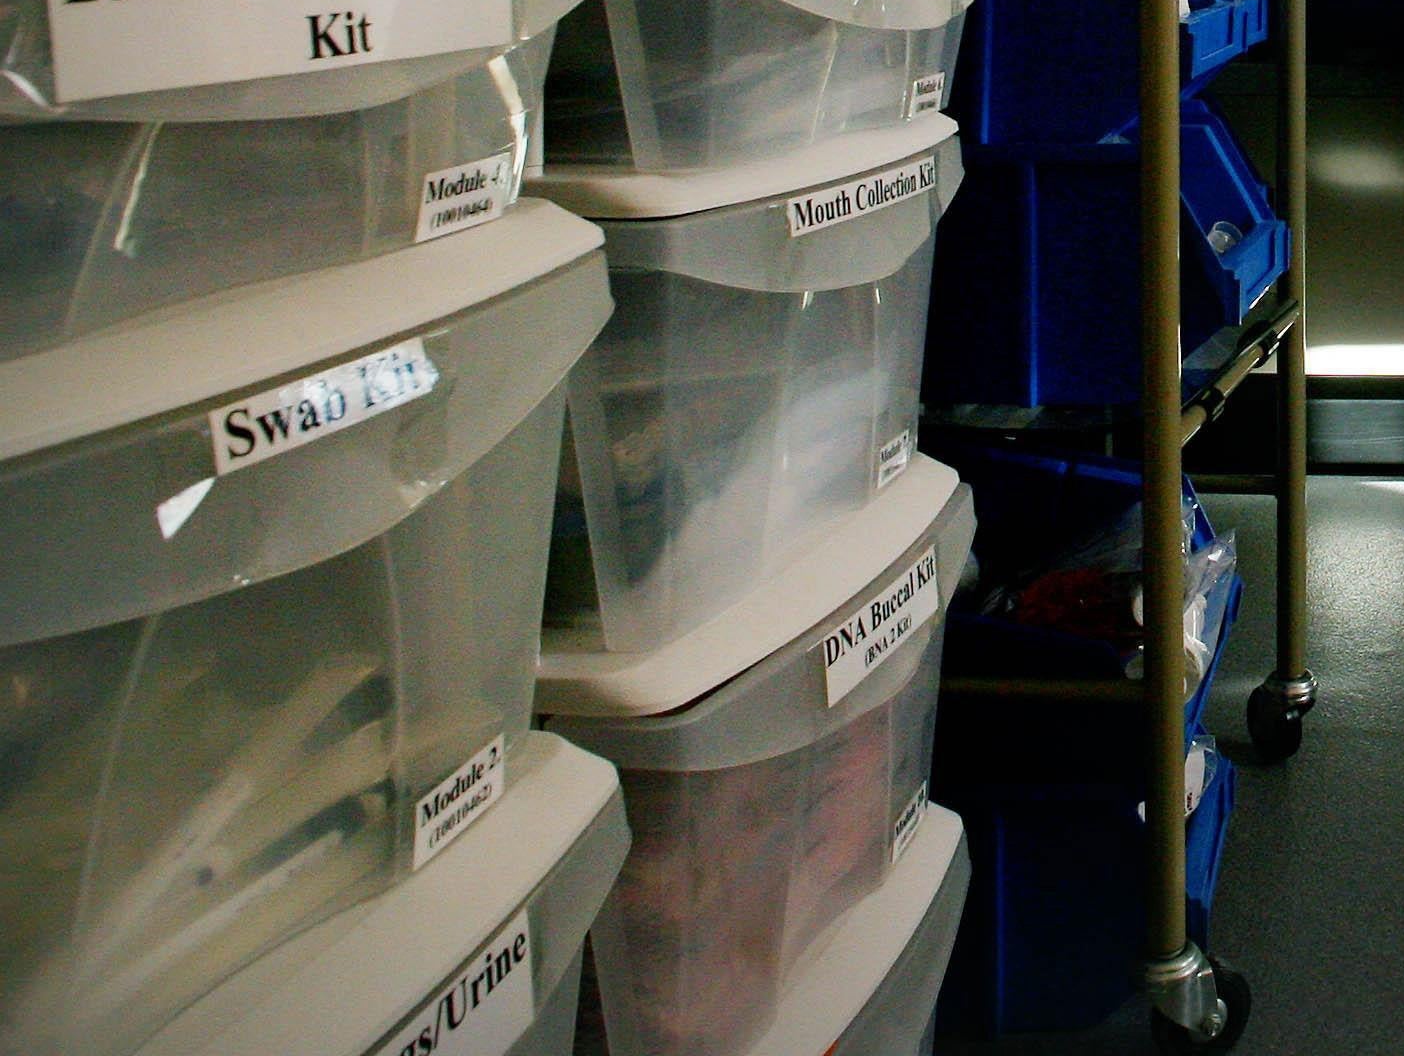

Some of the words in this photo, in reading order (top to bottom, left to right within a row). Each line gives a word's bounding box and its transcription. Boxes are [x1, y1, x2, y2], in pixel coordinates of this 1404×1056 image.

[305, 11, 374, 61] Kit
[425, 169, 488, 204] Module
[794, 190, 852, 231] Mouth
[856, 173, 917, 211] Collection
[919, 161, 935, 190] Kit
[824, 616, 867, 668] DNA
[870, 571, 915, 632] Buccal
[916, 553, 935, 591] Kit
[890, 626, 896, 644] 2
[421, 763, 485, 828] Module
